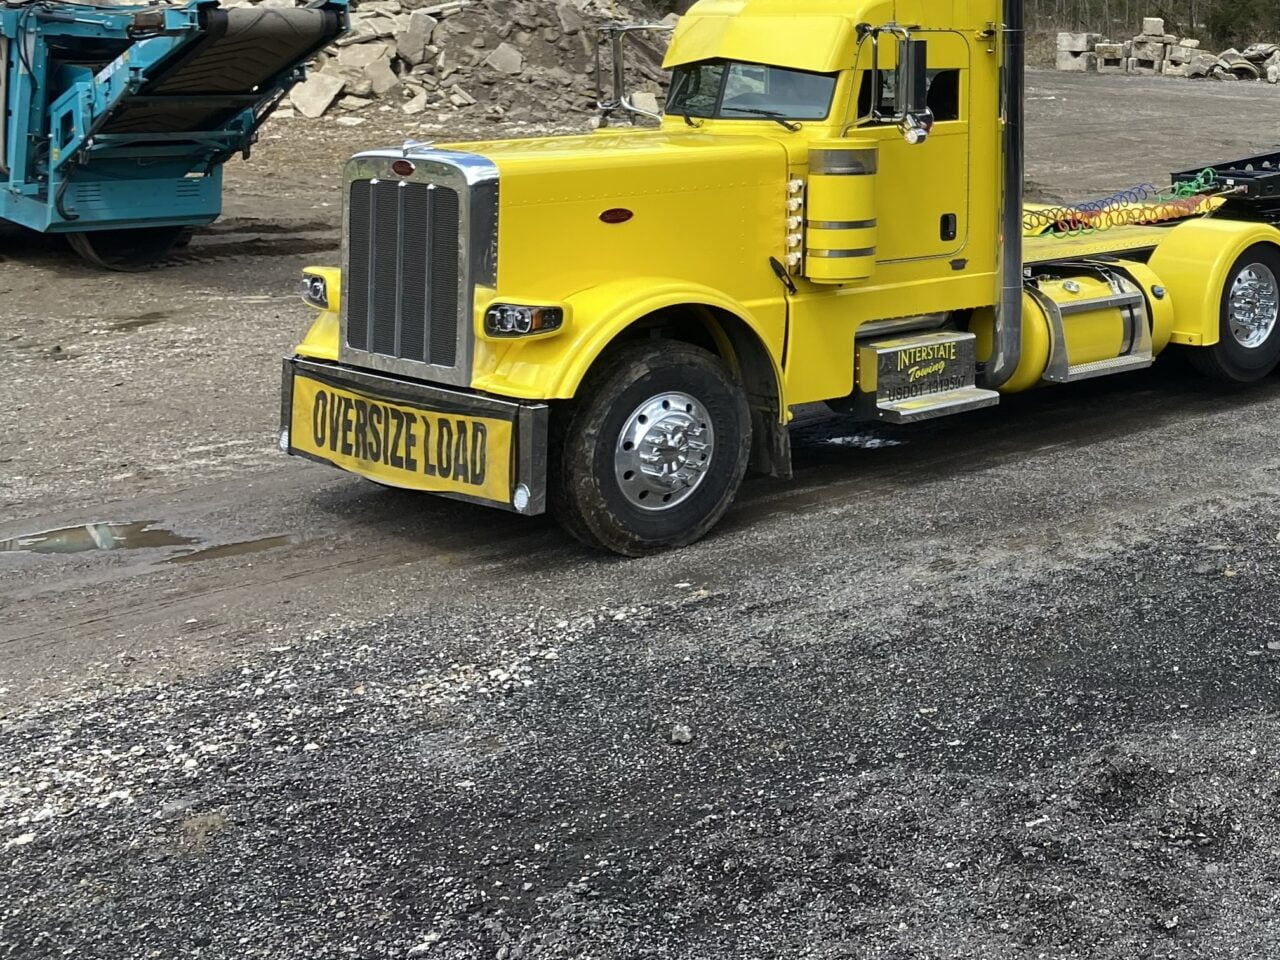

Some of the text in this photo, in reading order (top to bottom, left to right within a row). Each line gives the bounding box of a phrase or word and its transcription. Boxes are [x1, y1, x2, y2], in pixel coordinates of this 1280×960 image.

[897, 342, 956, 371] INTERSTATE
[908, 360, 945, 382] Towing
[888, 383, 923, 401] USDOT
[313, 390, 487, 485] OVERSIZE LOAD
